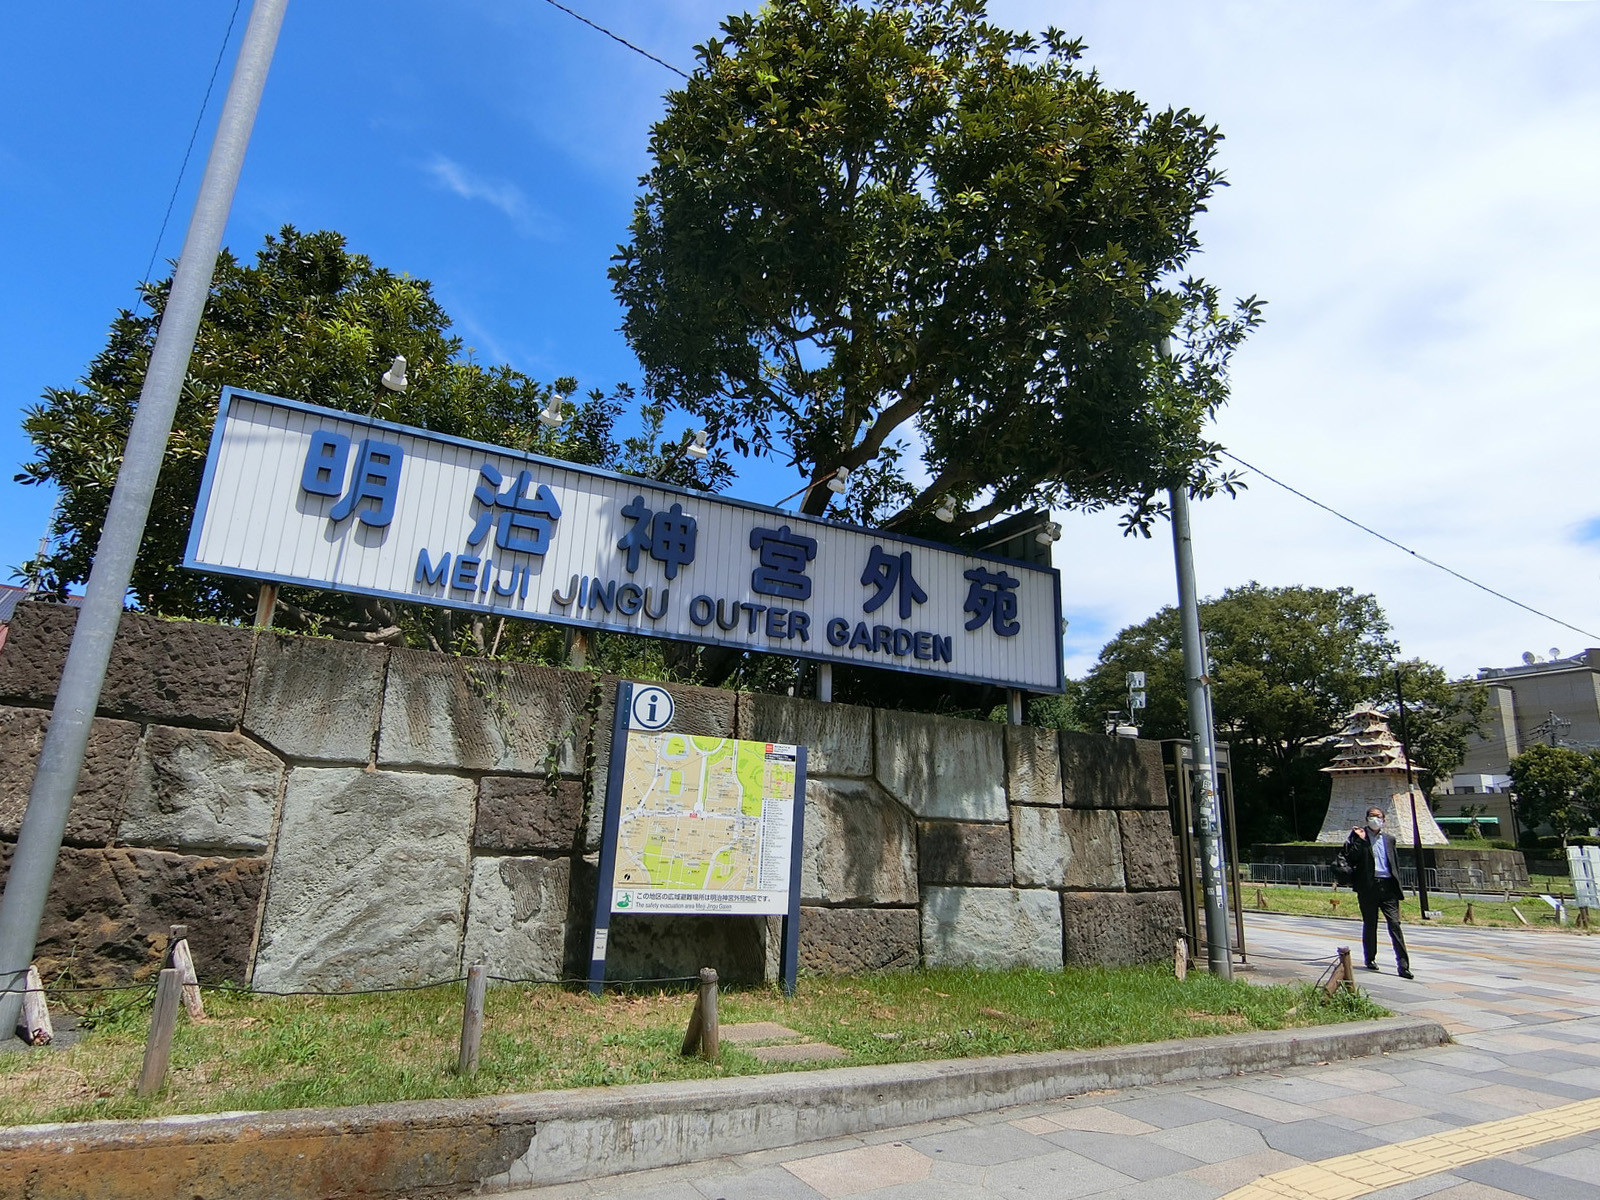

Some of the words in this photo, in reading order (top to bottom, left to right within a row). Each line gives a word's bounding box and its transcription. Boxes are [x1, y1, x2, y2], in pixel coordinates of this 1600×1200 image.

[301, 430, 1020, 637] 明治神宮外苑
[414, 548, 530, 600] MEIJI
[552, 574, 669, 620] JINGU
[689, 594, 811, 642] OUTER
[826, 617, 953, 664] GARDEN
